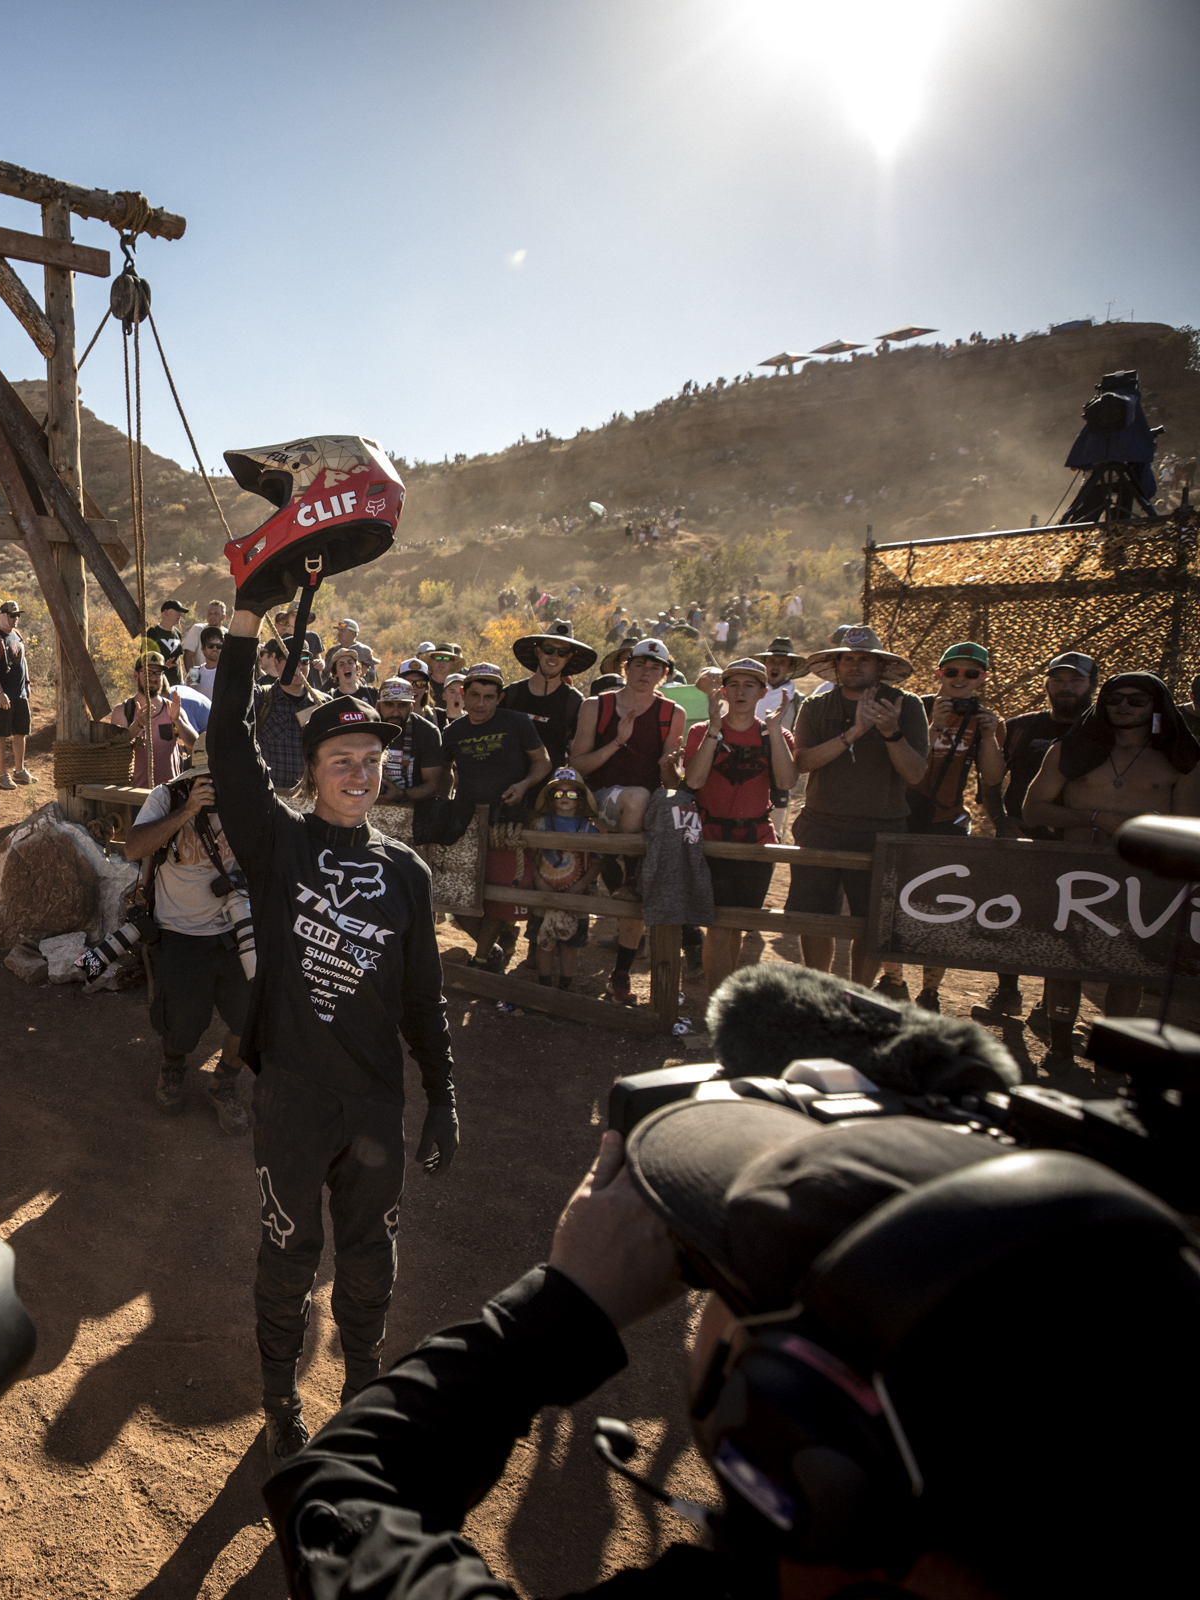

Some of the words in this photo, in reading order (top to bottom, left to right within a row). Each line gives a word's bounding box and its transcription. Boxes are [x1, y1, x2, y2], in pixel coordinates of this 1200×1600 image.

[266, 451, 292, 464] FOX
[296, 490, 358, 528] CLIF
[343, 713, 363, 722] CLIF
[458, 732, 508, 745] PIVOT
[899, 864, 1022, 929] Go
[296, 882, 396, 945] TREK
[300, 921, 337, 946] CLIF
[304, 945, 365, 978] SHIMANO
[341, 939, 382, 965] FOX
[313, 965, 360, 985] BONTRAGER
[332, 982, 356, 995] TEN
